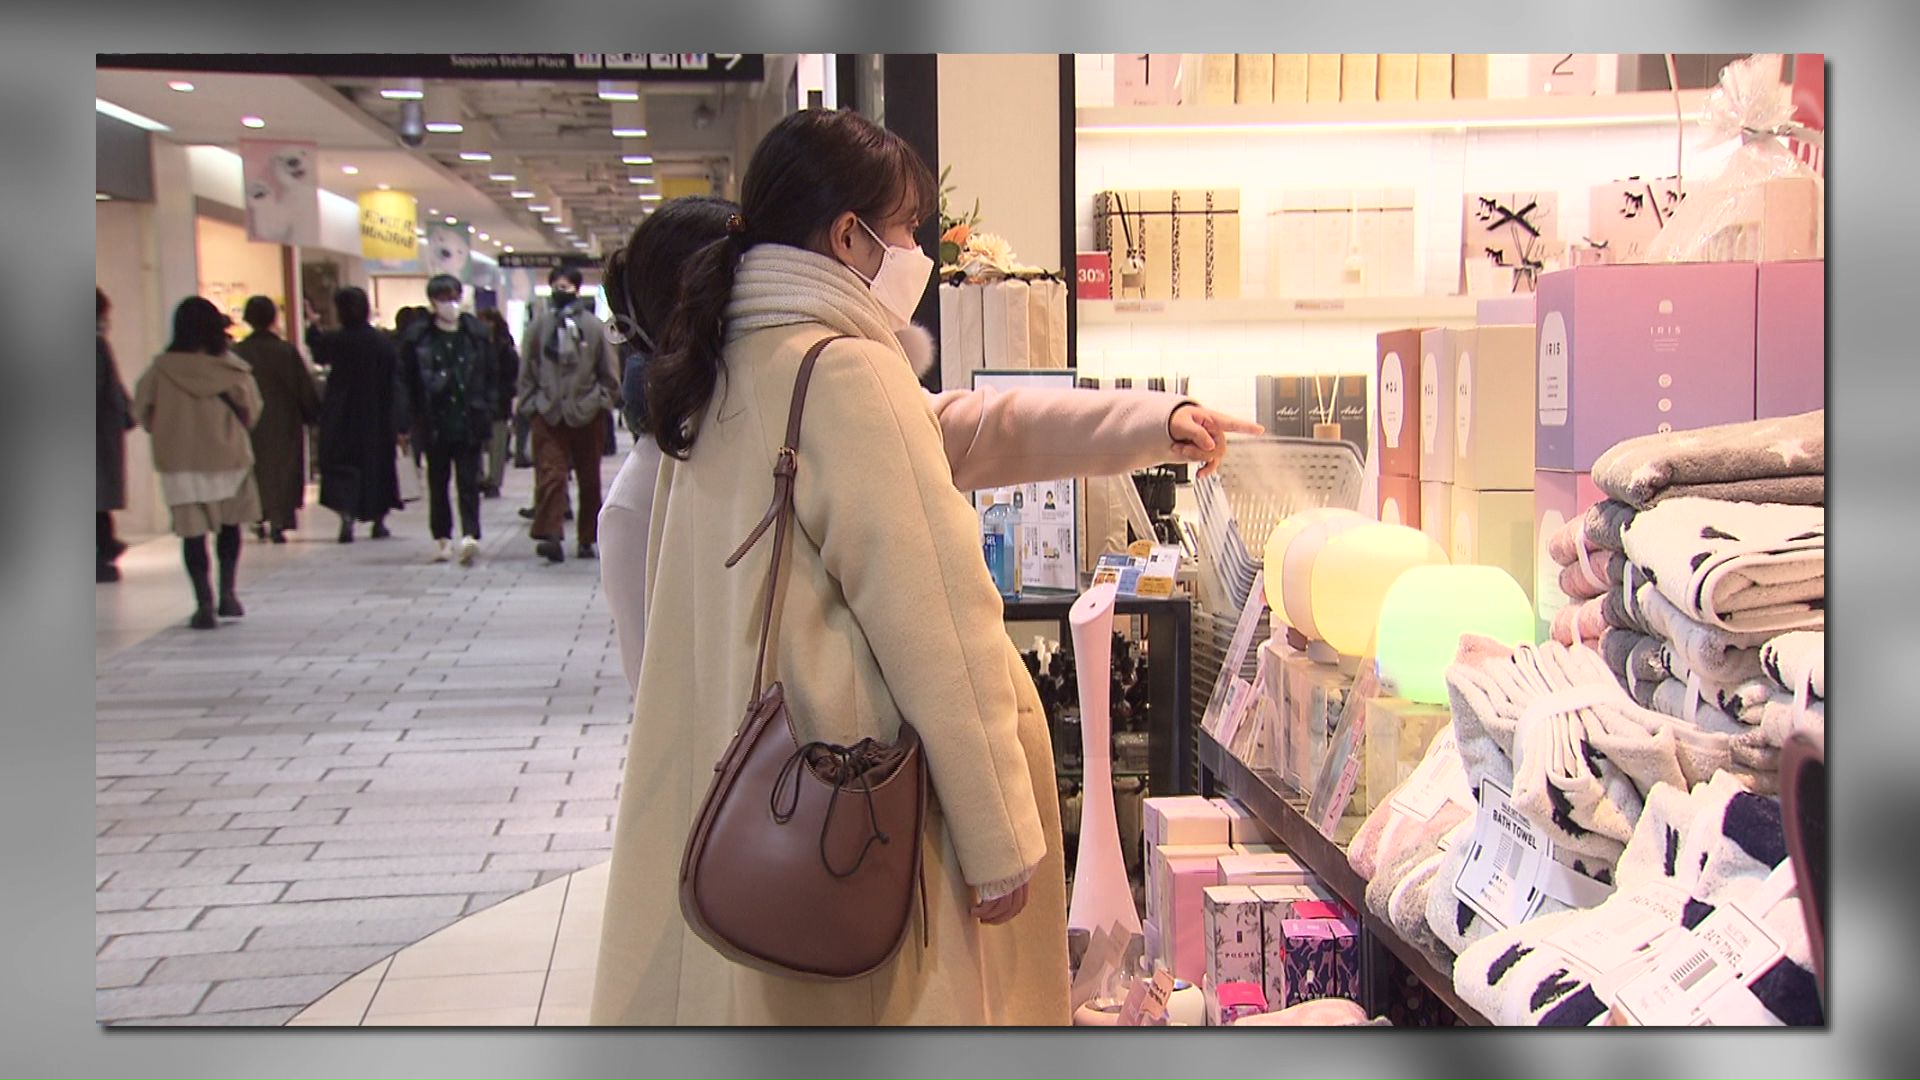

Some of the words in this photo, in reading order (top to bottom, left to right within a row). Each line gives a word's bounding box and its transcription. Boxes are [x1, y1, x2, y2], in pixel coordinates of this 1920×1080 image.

[450, 54, 498, 69] Sapporo
[500, 54, 535, 68] Stellar
[537, 54, 567, 68] Place
[1650, 325, 1681, 336] IRIS
[1492, 809, 1511, 831] BATH
[1512, 822, 1537, 850] TOWEL
